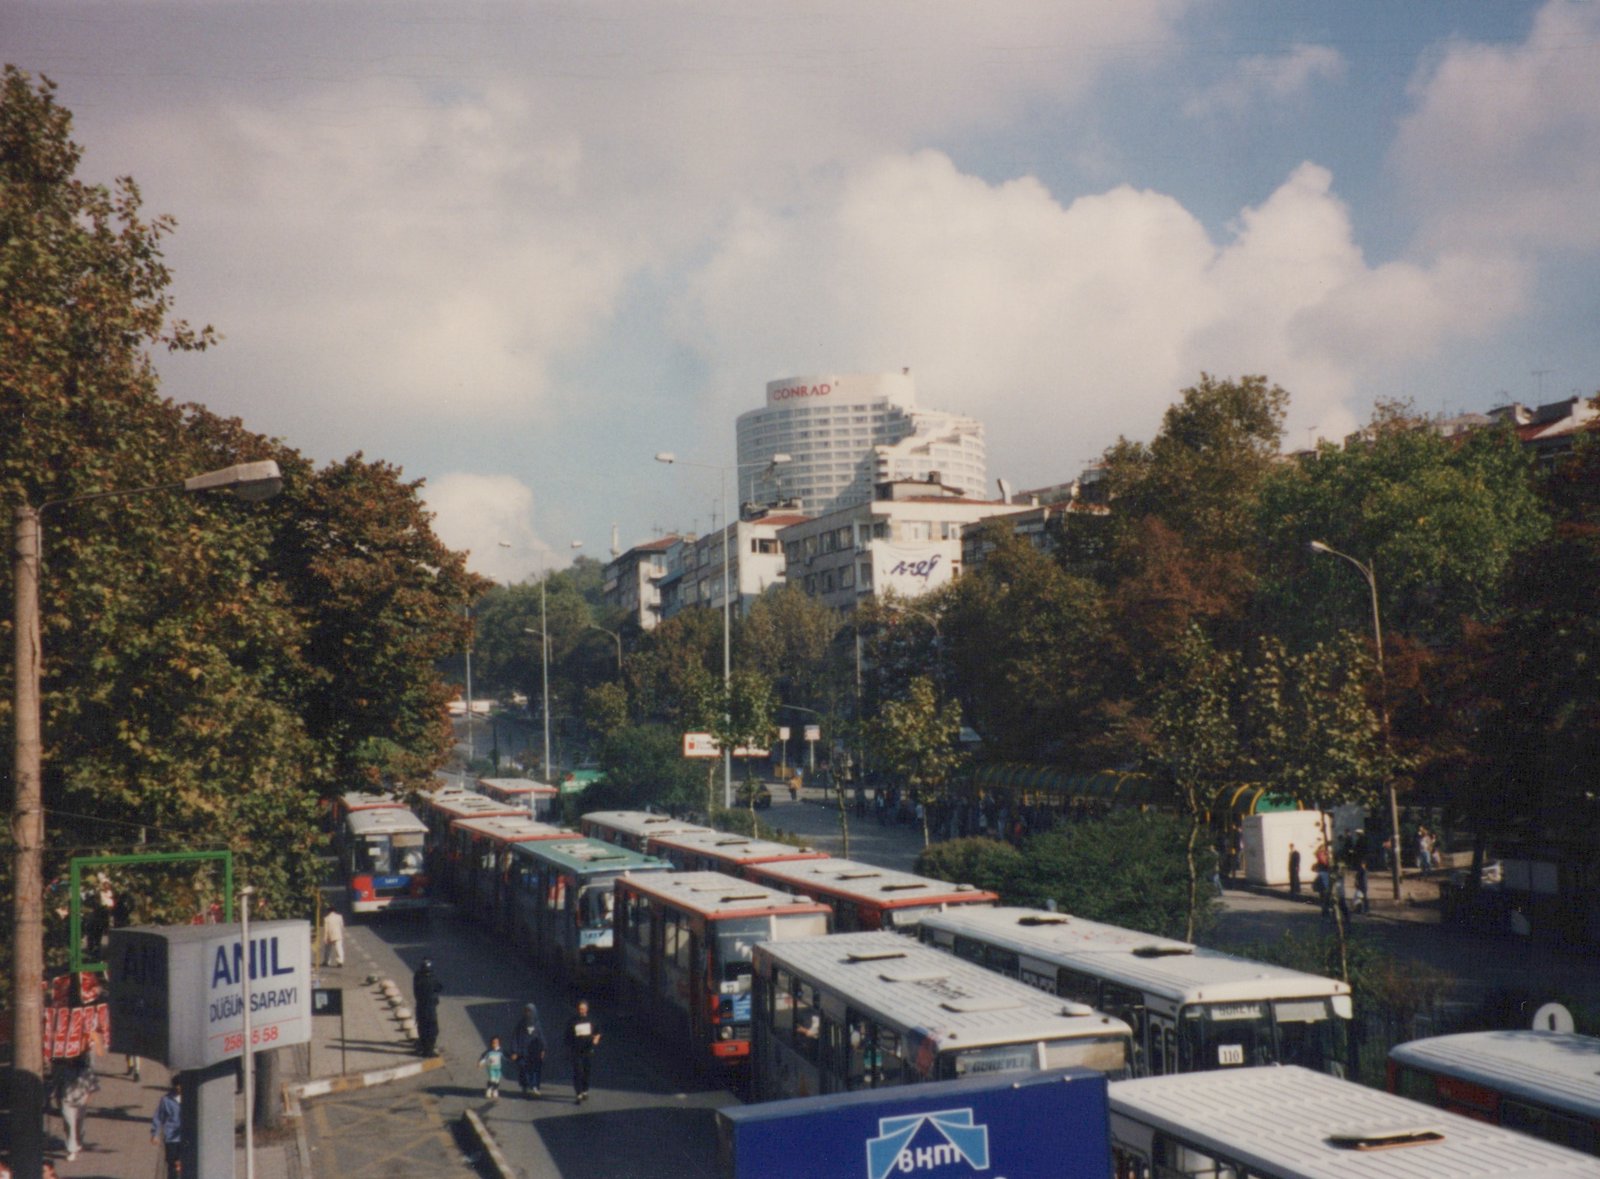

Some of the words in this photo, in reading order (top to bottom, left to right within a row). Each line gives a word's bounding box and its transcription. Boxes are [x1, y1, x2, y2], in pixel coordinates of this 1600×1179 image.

[773, 384, 831, 400] CONRAD
[212, 937, 294, 988] ANIL
[250, 987, 297, 1012] SARAYI
[263, 1026, 278, 1041] 58
[1223, 1050, 1239, 1063] 110
